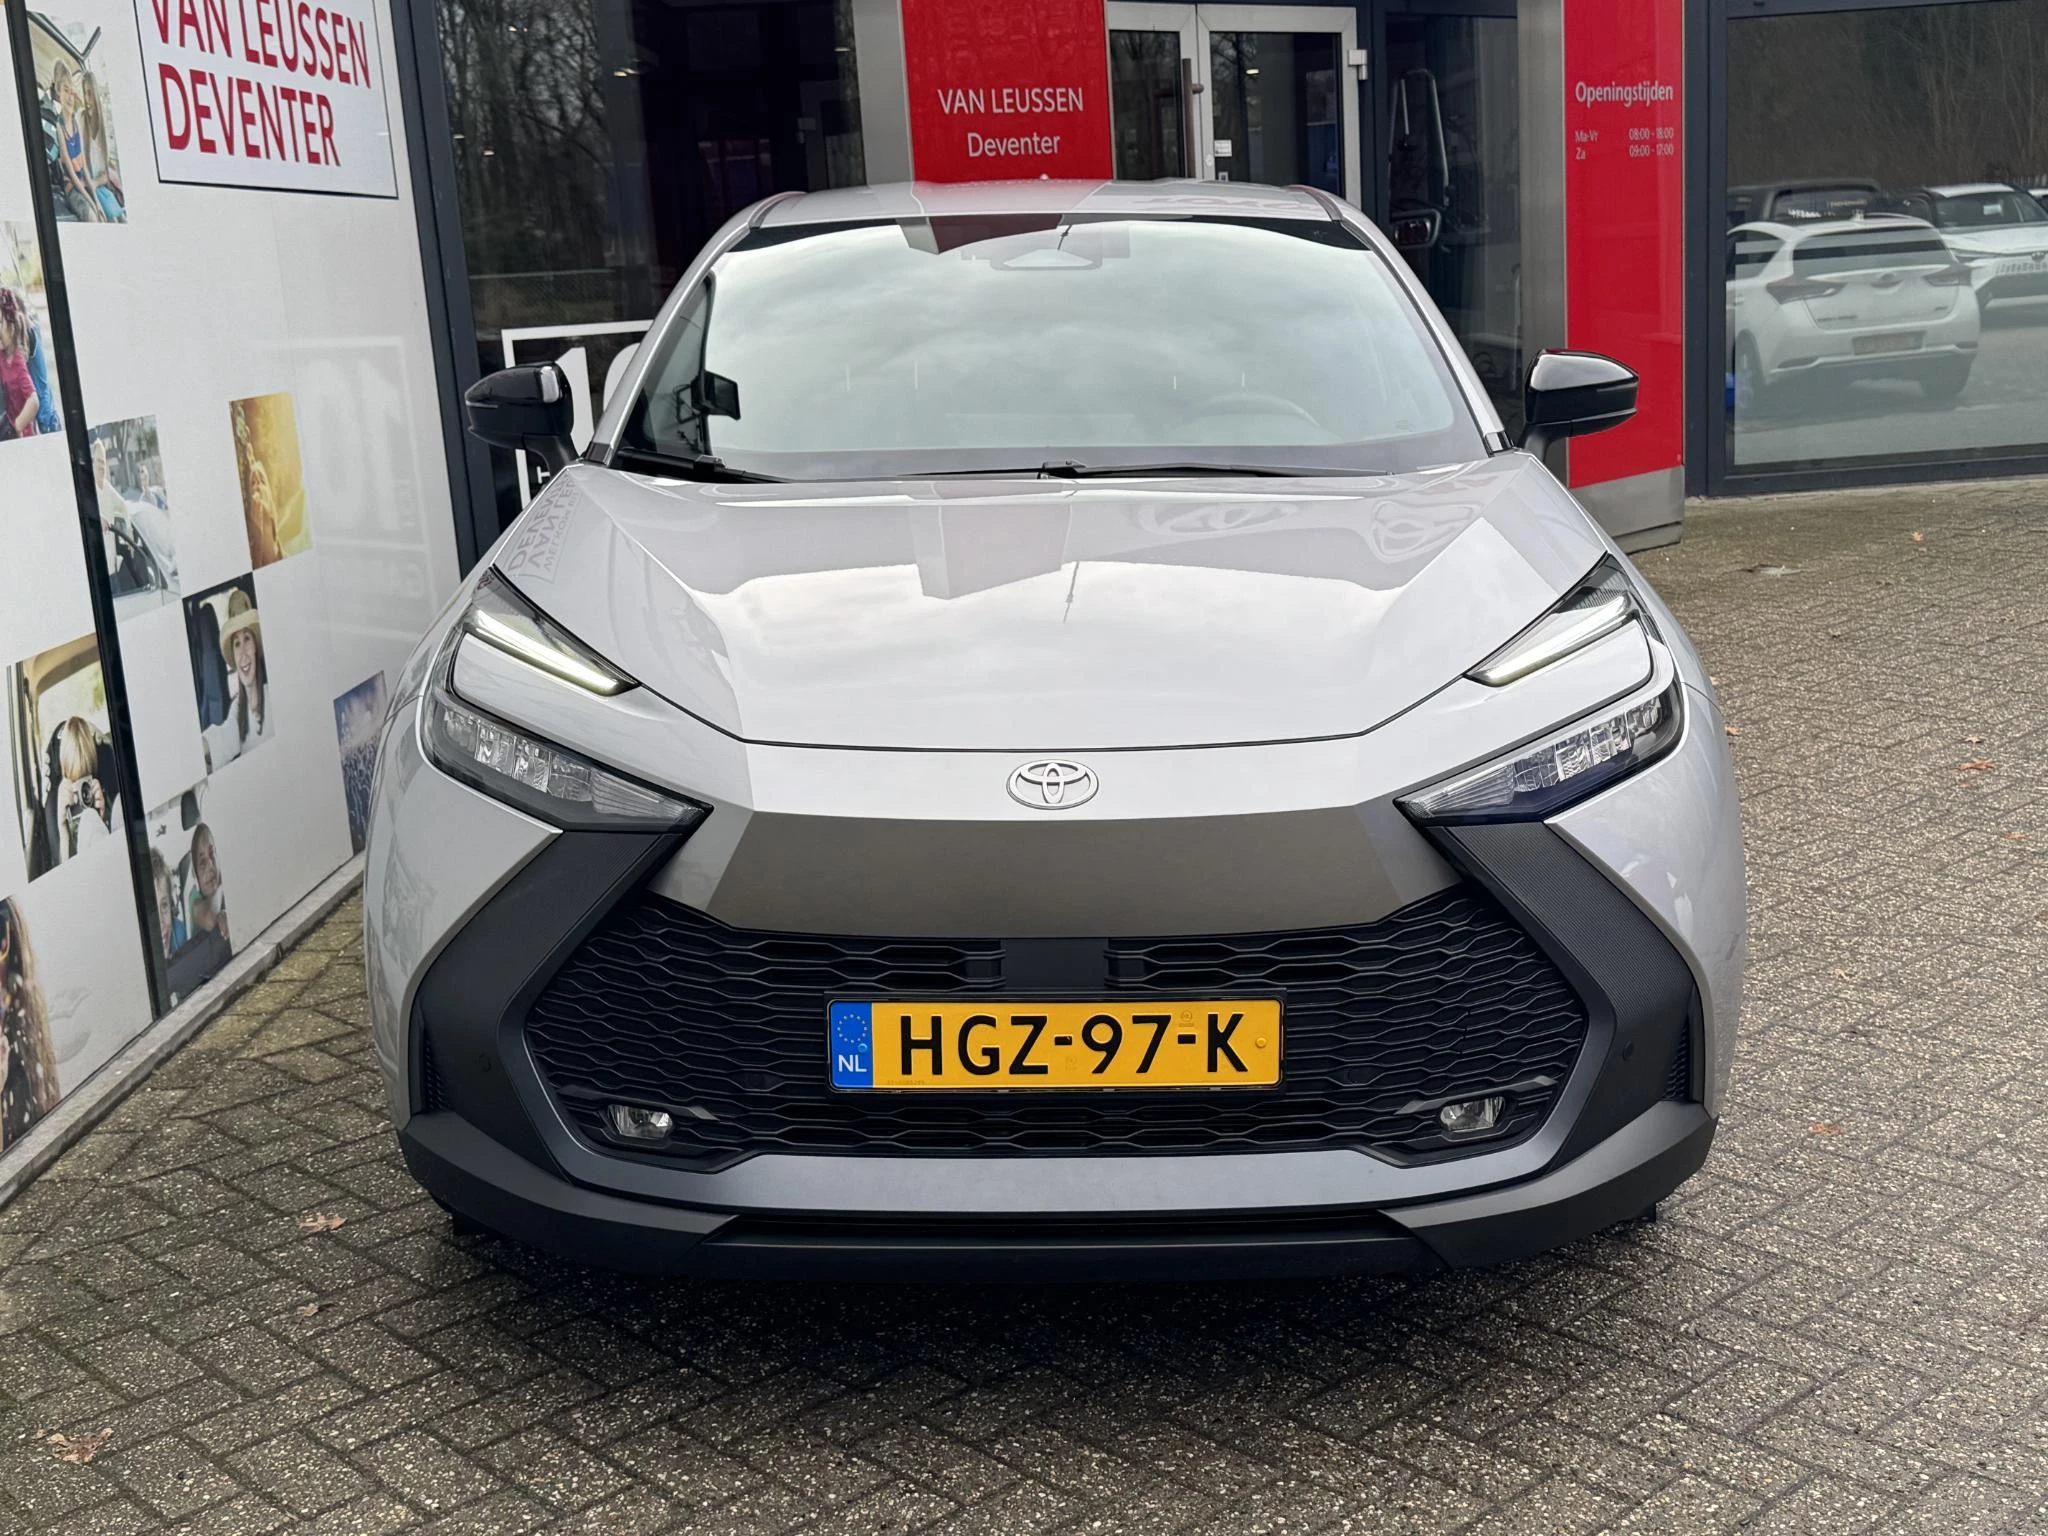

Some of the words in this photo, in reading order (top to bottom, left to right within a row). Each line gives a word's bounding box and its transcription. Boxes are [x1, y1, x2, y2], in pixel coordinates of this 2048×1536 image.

[239, 0, 371, 89] LEUSSEN
[937, 88, 985, 115] VAN
[991, 87, 1084, 114] LEUSSEN
[1575, 80, 1674, 108] Openingstijden
[158, 62, 341, 167] DEVENTER
[967, 131, 1061, 158] Deventer
[900, 1013, 1249, 1076] HGZ-97-K
[838, 1053, 868, 1073] NL
